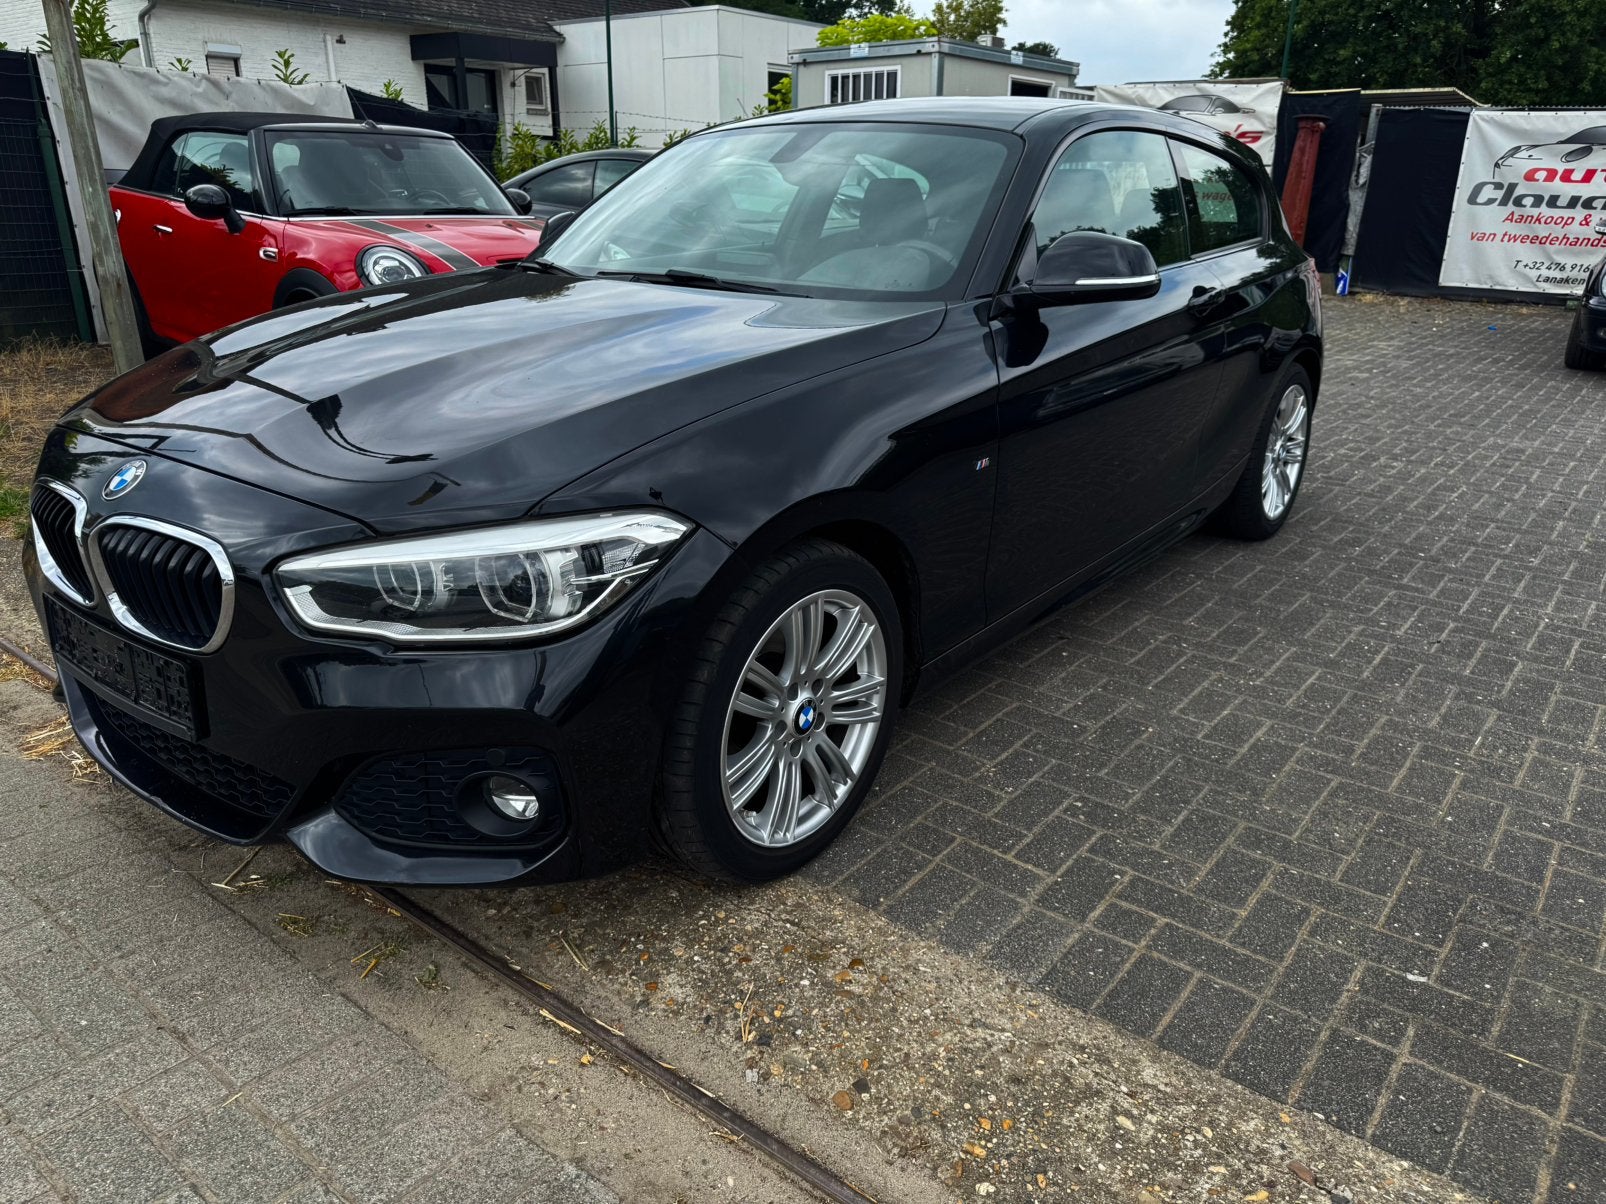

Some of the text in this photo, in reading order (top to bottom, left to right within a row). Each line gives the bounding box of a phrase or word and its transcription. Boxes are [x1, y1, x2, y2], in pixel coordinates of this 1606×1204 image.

[1502, 211, 1592, 229] Aankoop &
[1470, 231, 1497, 243] van
[1513, 259, 1591, 273] T +32 476 916
[1535, 274, 1586, 285] Lanaken
